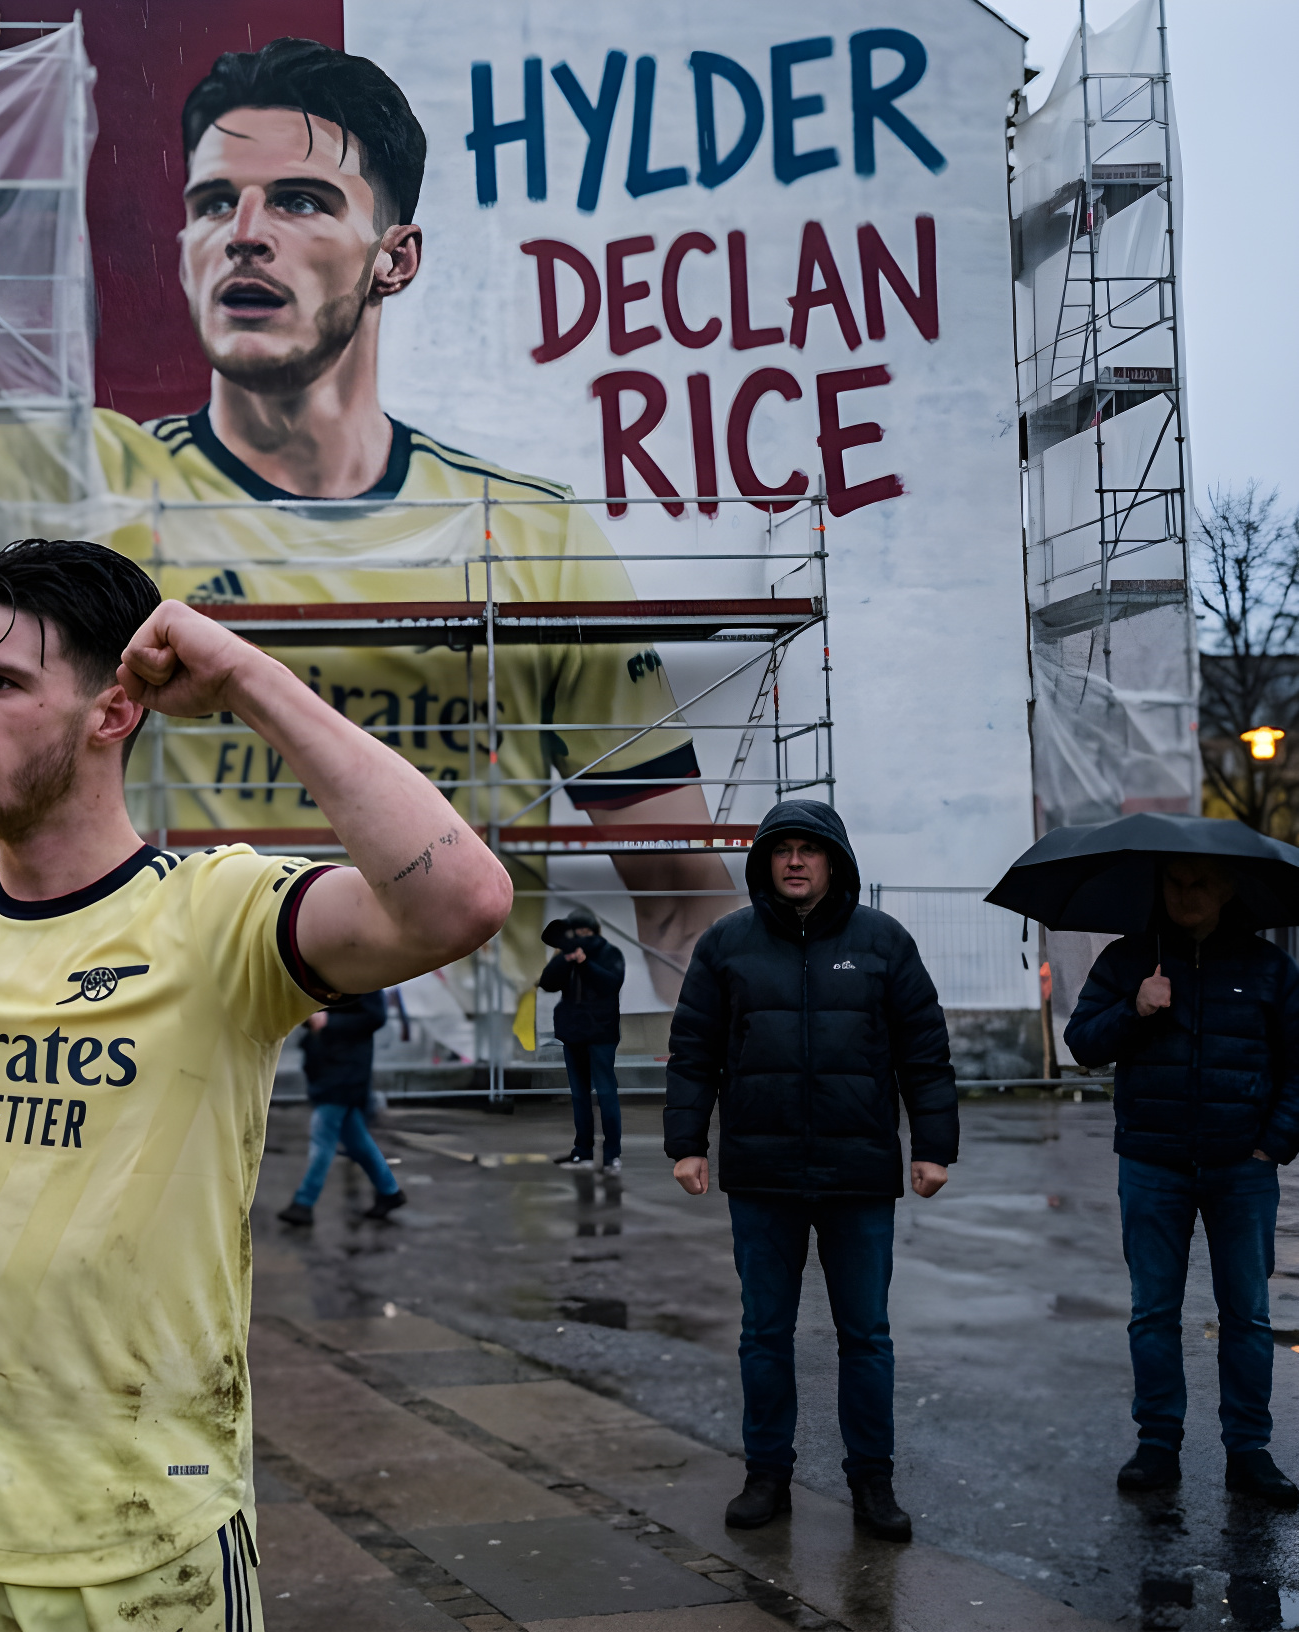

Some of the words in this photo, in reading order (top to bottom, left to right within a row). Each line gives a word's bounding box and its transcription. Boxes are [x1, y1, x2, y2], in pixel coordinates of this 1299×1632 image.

[465, 27, 948, 214] HYLDER
[519, 212, 940, 364] DECLAN
[592, 364, 909, 520] RICE
[195, 665, 505, 756] rates
[214, 743, 283, 804] FLY
